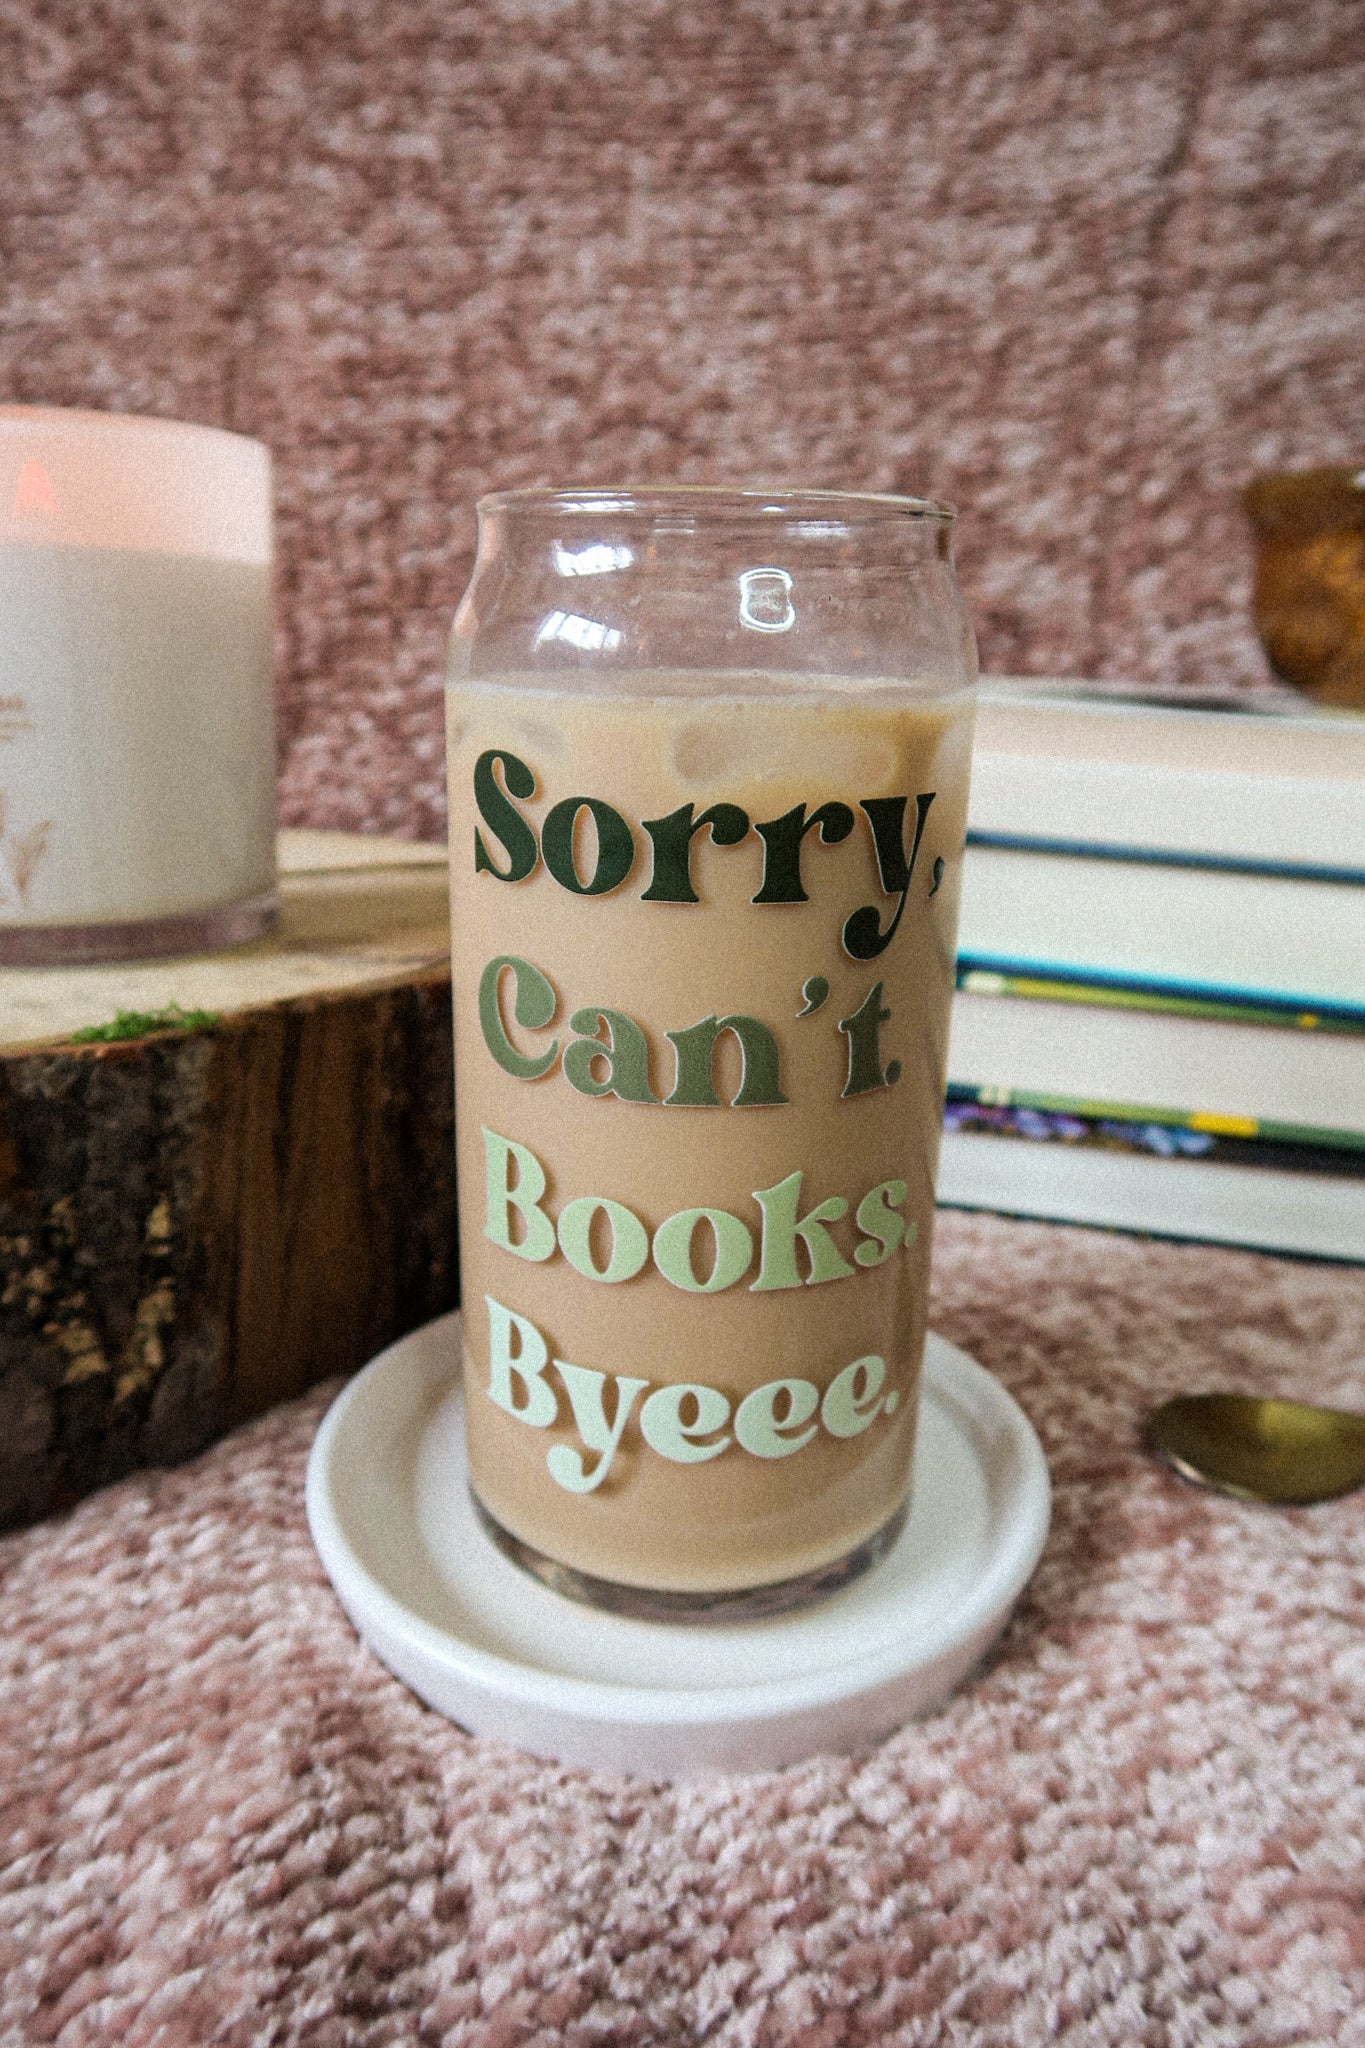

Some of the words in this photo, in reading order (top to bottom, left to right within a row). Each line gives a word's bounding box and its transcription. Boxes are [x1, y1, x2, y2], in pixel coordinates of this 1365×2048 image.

[474, 749, 945, 960] Sorry,
[478, 955, 901, 1108] Can't.
[481, 1126, 918, 1293] Books.
[484, 1294, 899, 1494] Byeee.
